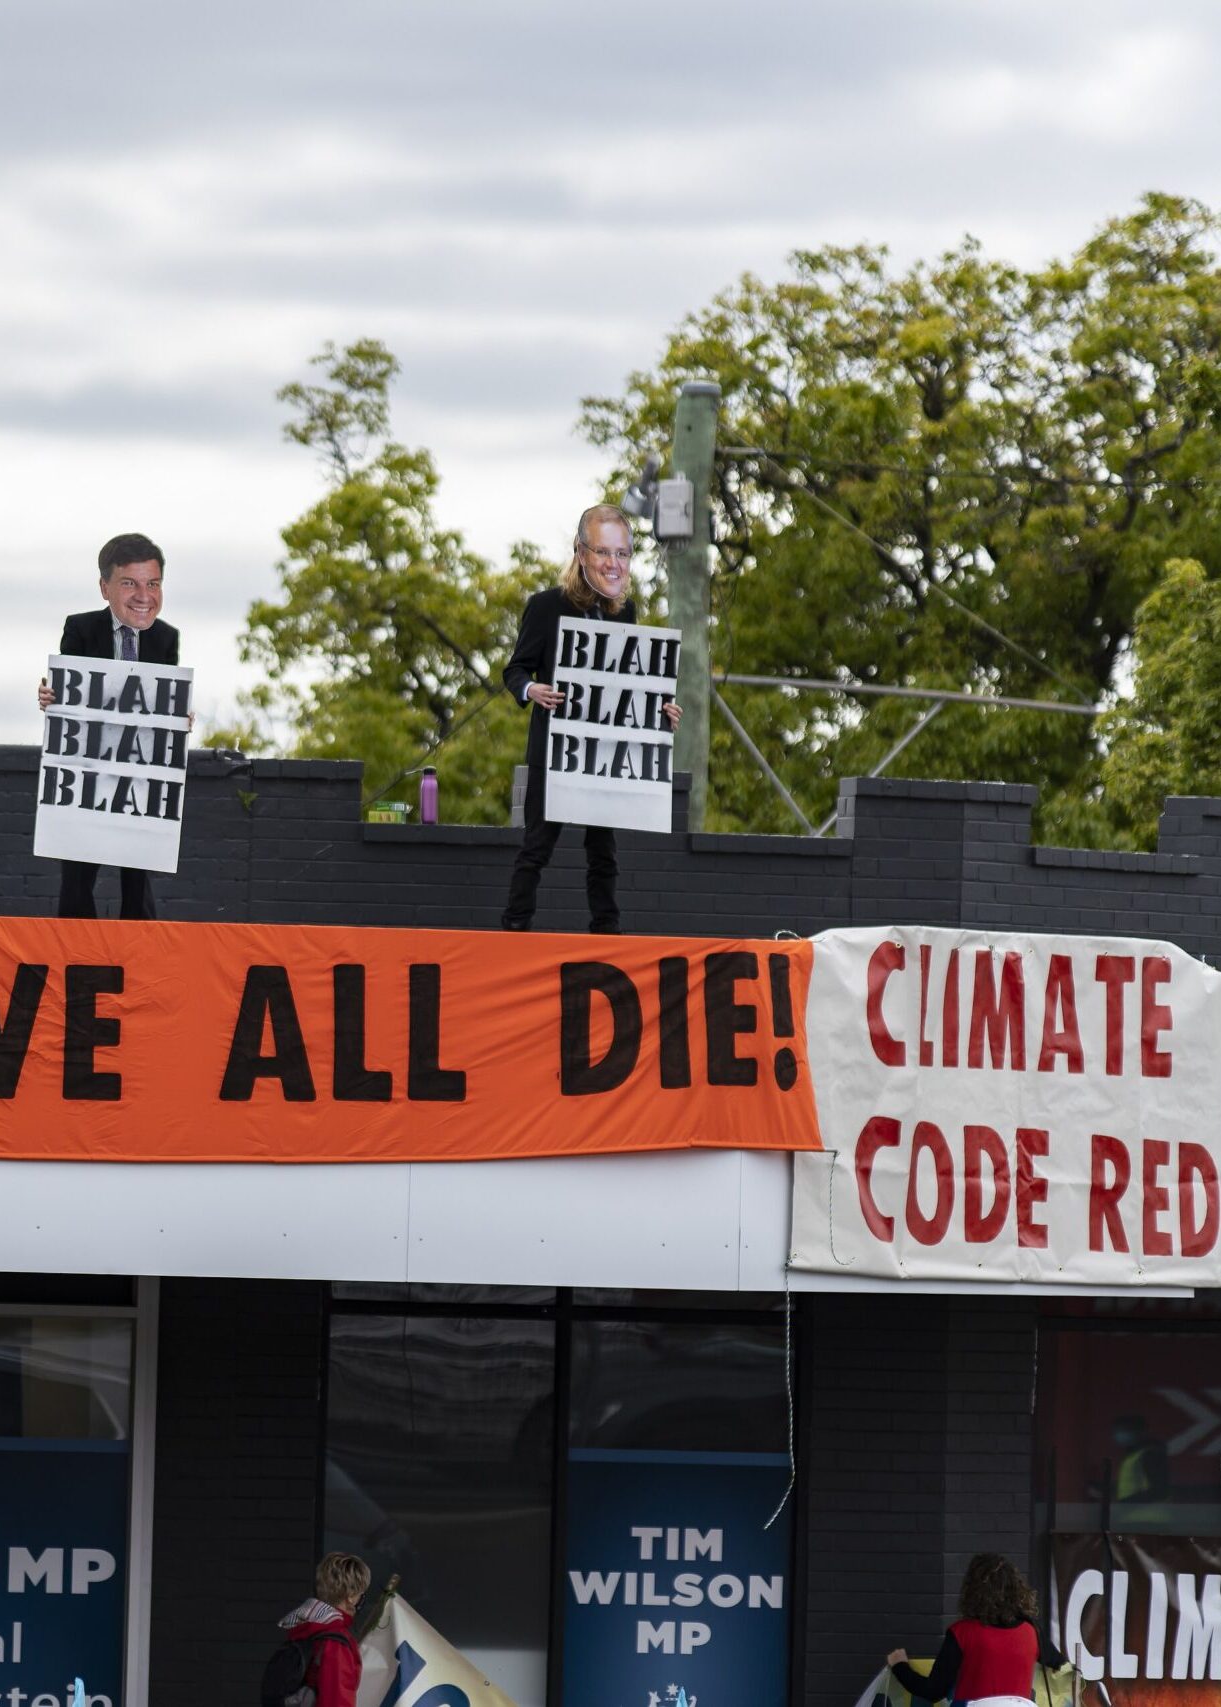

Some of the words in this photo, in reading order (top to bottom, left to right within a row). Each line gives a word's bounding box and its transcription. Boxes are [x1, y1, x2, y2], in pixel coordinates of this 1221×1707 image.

[557, 628, 681, 679] BLAH
[49, 666, 192, 718] BLAH
[552, 680, 676, 733] BLAH
[44, 715, 190, 770] BLAH
[548, 732, 673, 783] BLAH
[39, 765, 184, 821] BLAH
[219, 962, 467, 1103] ALL
[560, 951, 799, 1097] DIE!
[866, 940, 1174, 1079] CLIMATE
[854, 1115, 1050, 1249] CODE
[1088, 1134, 1221, 1259] RED
[7, 1546, 116, 1594] MP
[631, 1527, 724, 1562] TIM
[568, 1570, 784, 1609] WILSON
[636, 1620, 712, 1655] MP
[1066, 1568, 1221, 1681] CLIM
